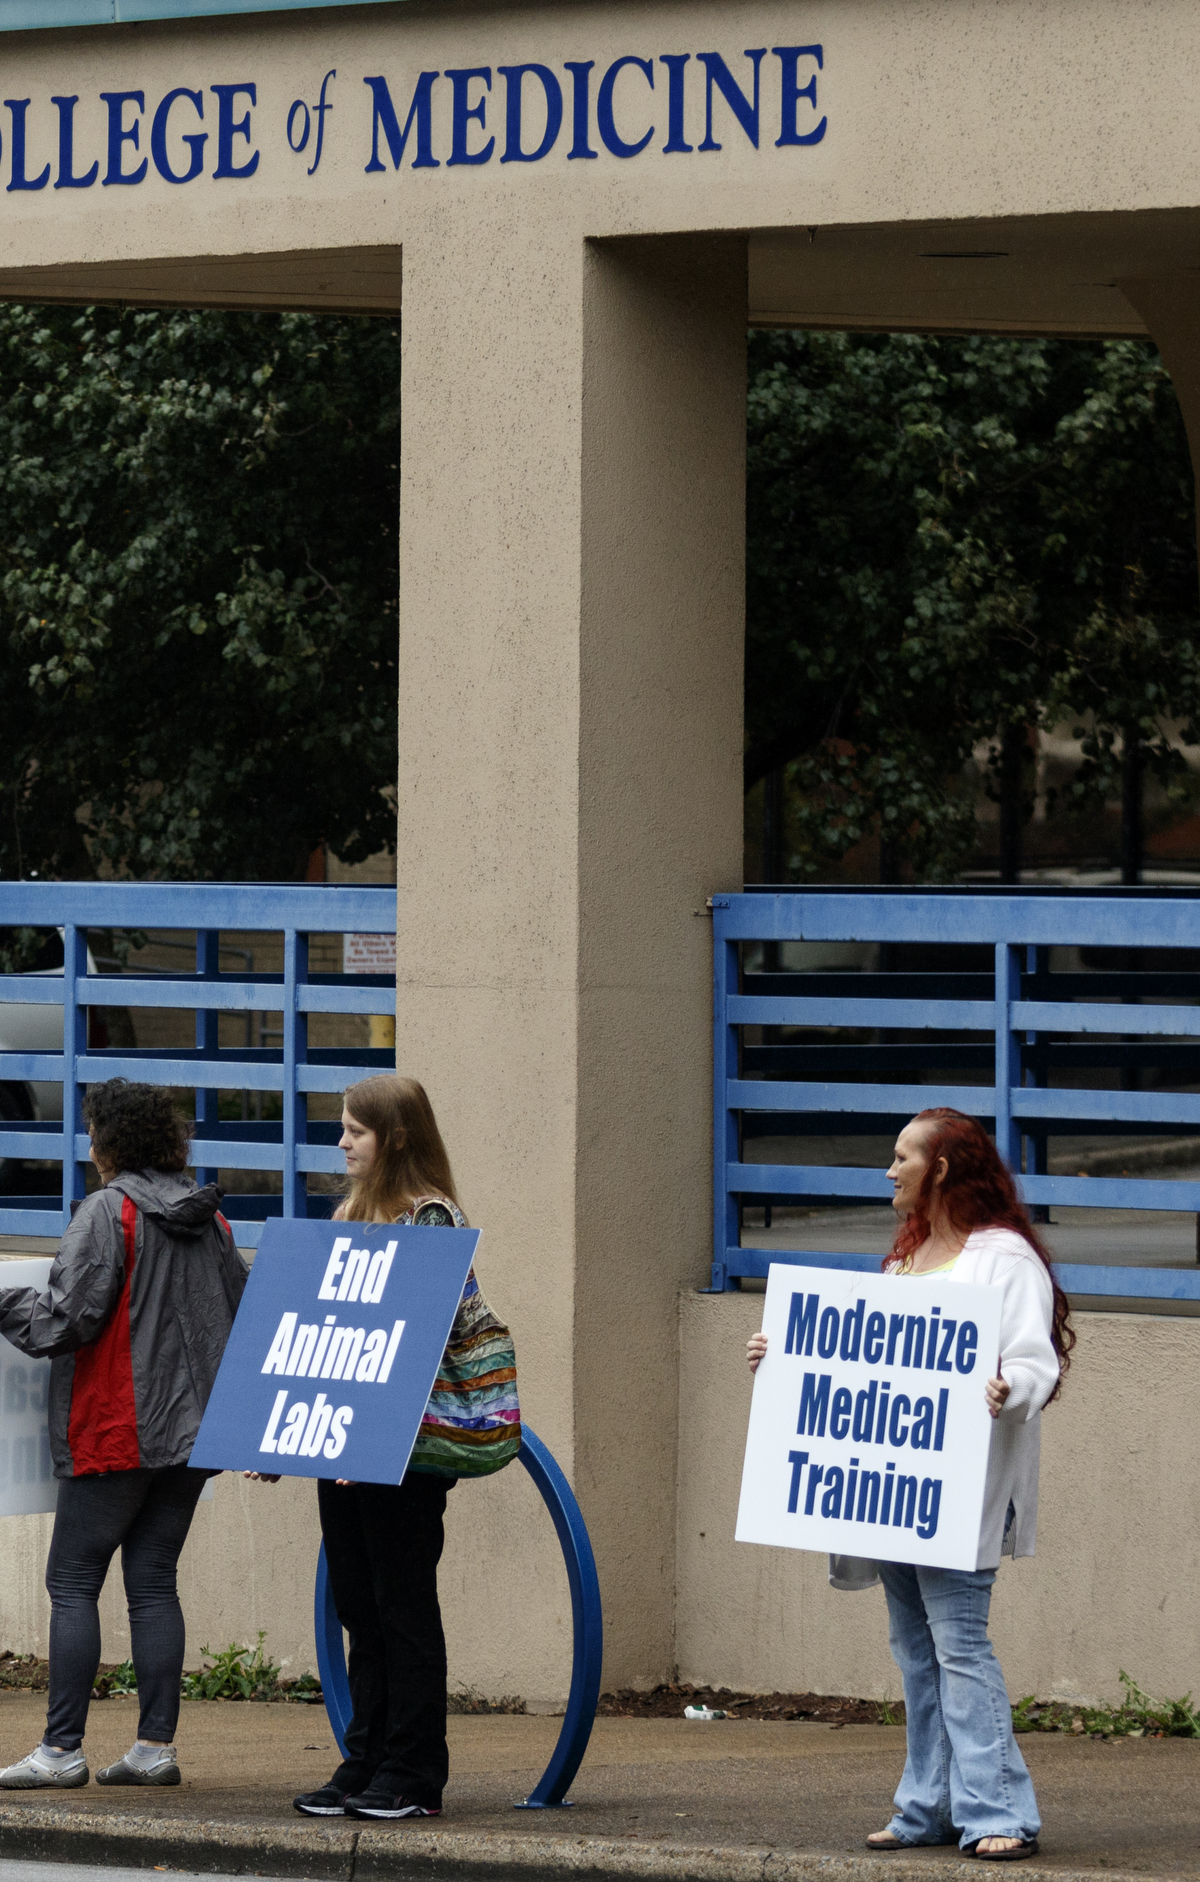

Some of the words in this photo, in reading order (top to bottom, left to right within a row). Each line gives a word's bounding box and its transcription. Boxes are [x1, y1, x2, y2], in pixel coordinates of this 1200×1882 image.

[287, 70, 337, 175] of
[364, 44, 828, 173] MEDICINE
[318, 1238, 399, 1304] End
[260, 1312, 406, 1384] Animal
[784, 1292, 978, 1375] Modernize
[260, 1391, 354, 1460] Labs
[796, 1373, 949, 1452] Medical
[787, 1451, 943, 1540] Training
